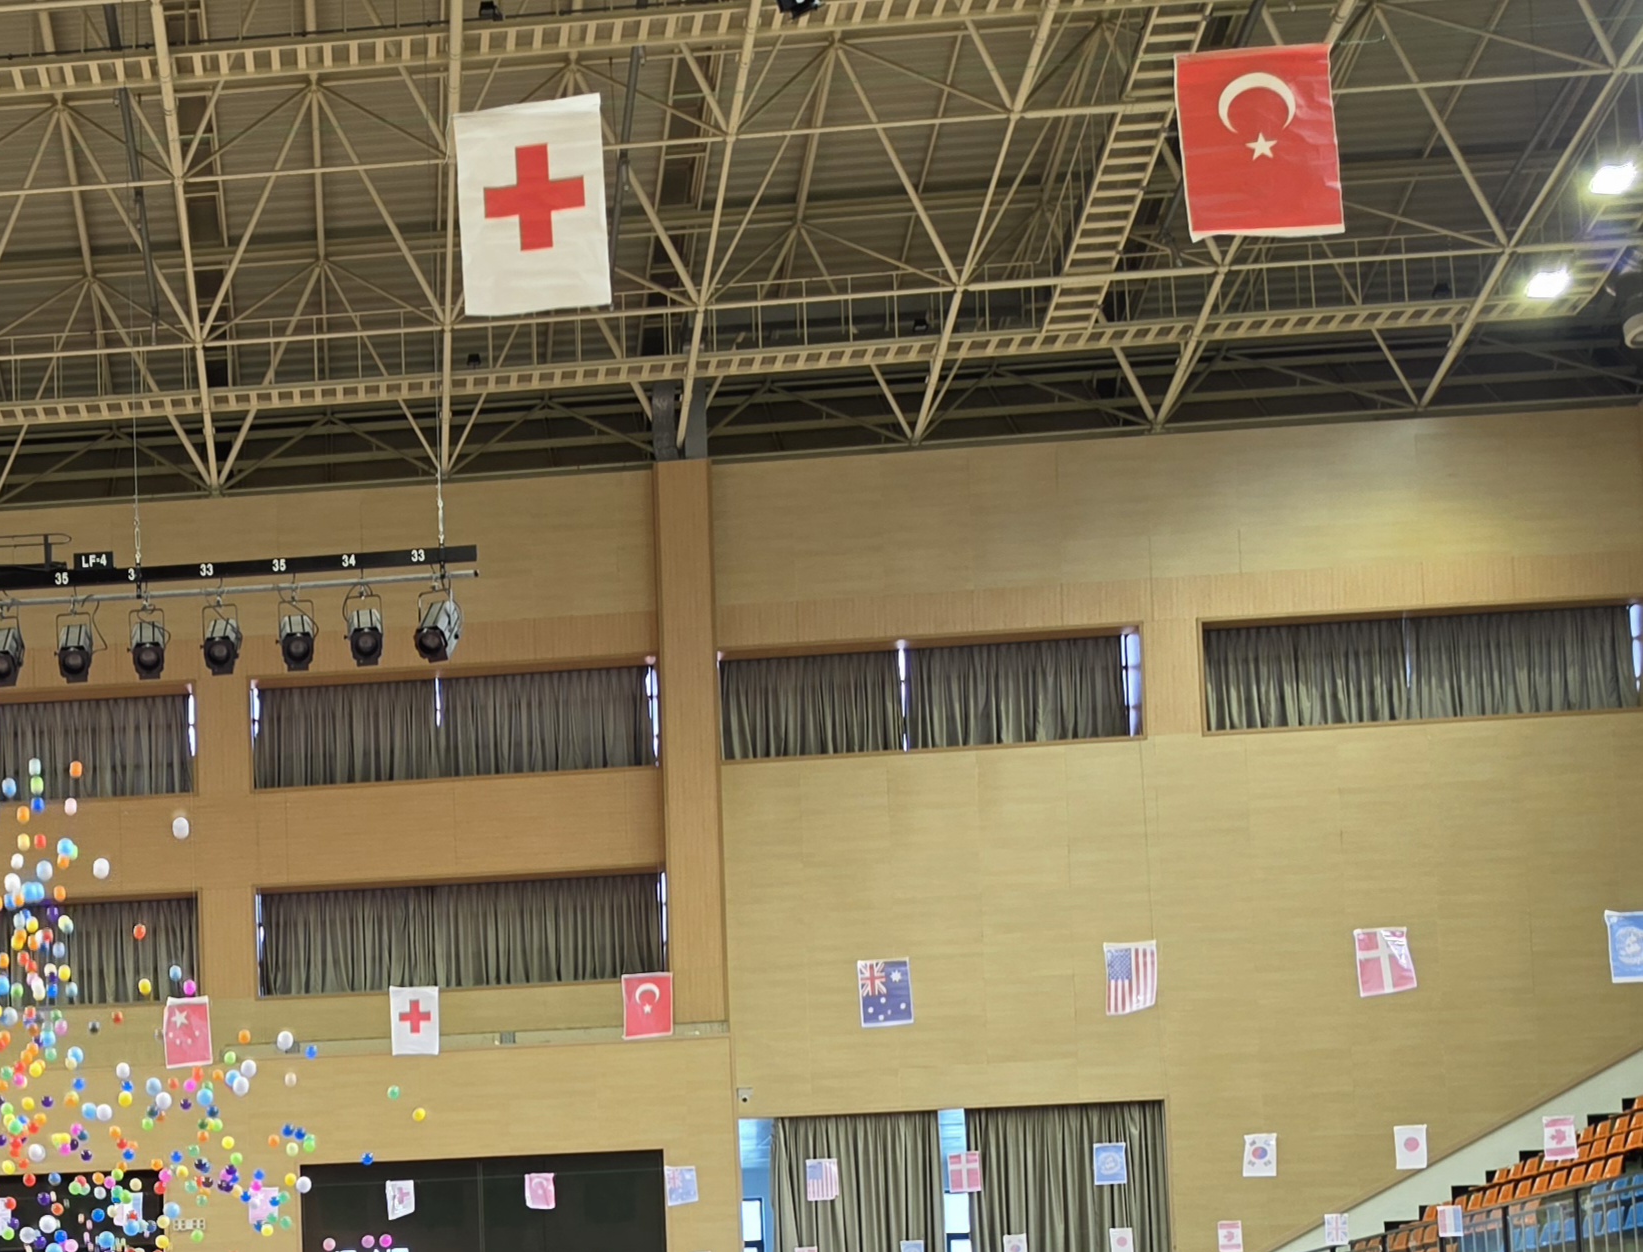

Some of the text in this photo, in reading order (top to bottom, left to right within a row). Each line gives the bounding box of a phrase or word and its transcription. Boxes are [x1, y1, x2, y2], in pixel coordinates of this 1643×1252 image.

[54, 571, 69, 585] 35
[199, 563, 214, 577] 33
[272, 558, 287, 572] 35
[341, 553, 356, 568] 34
[411, 548, 426, 563] 33
[81, 553, 107, 568] LF-4
